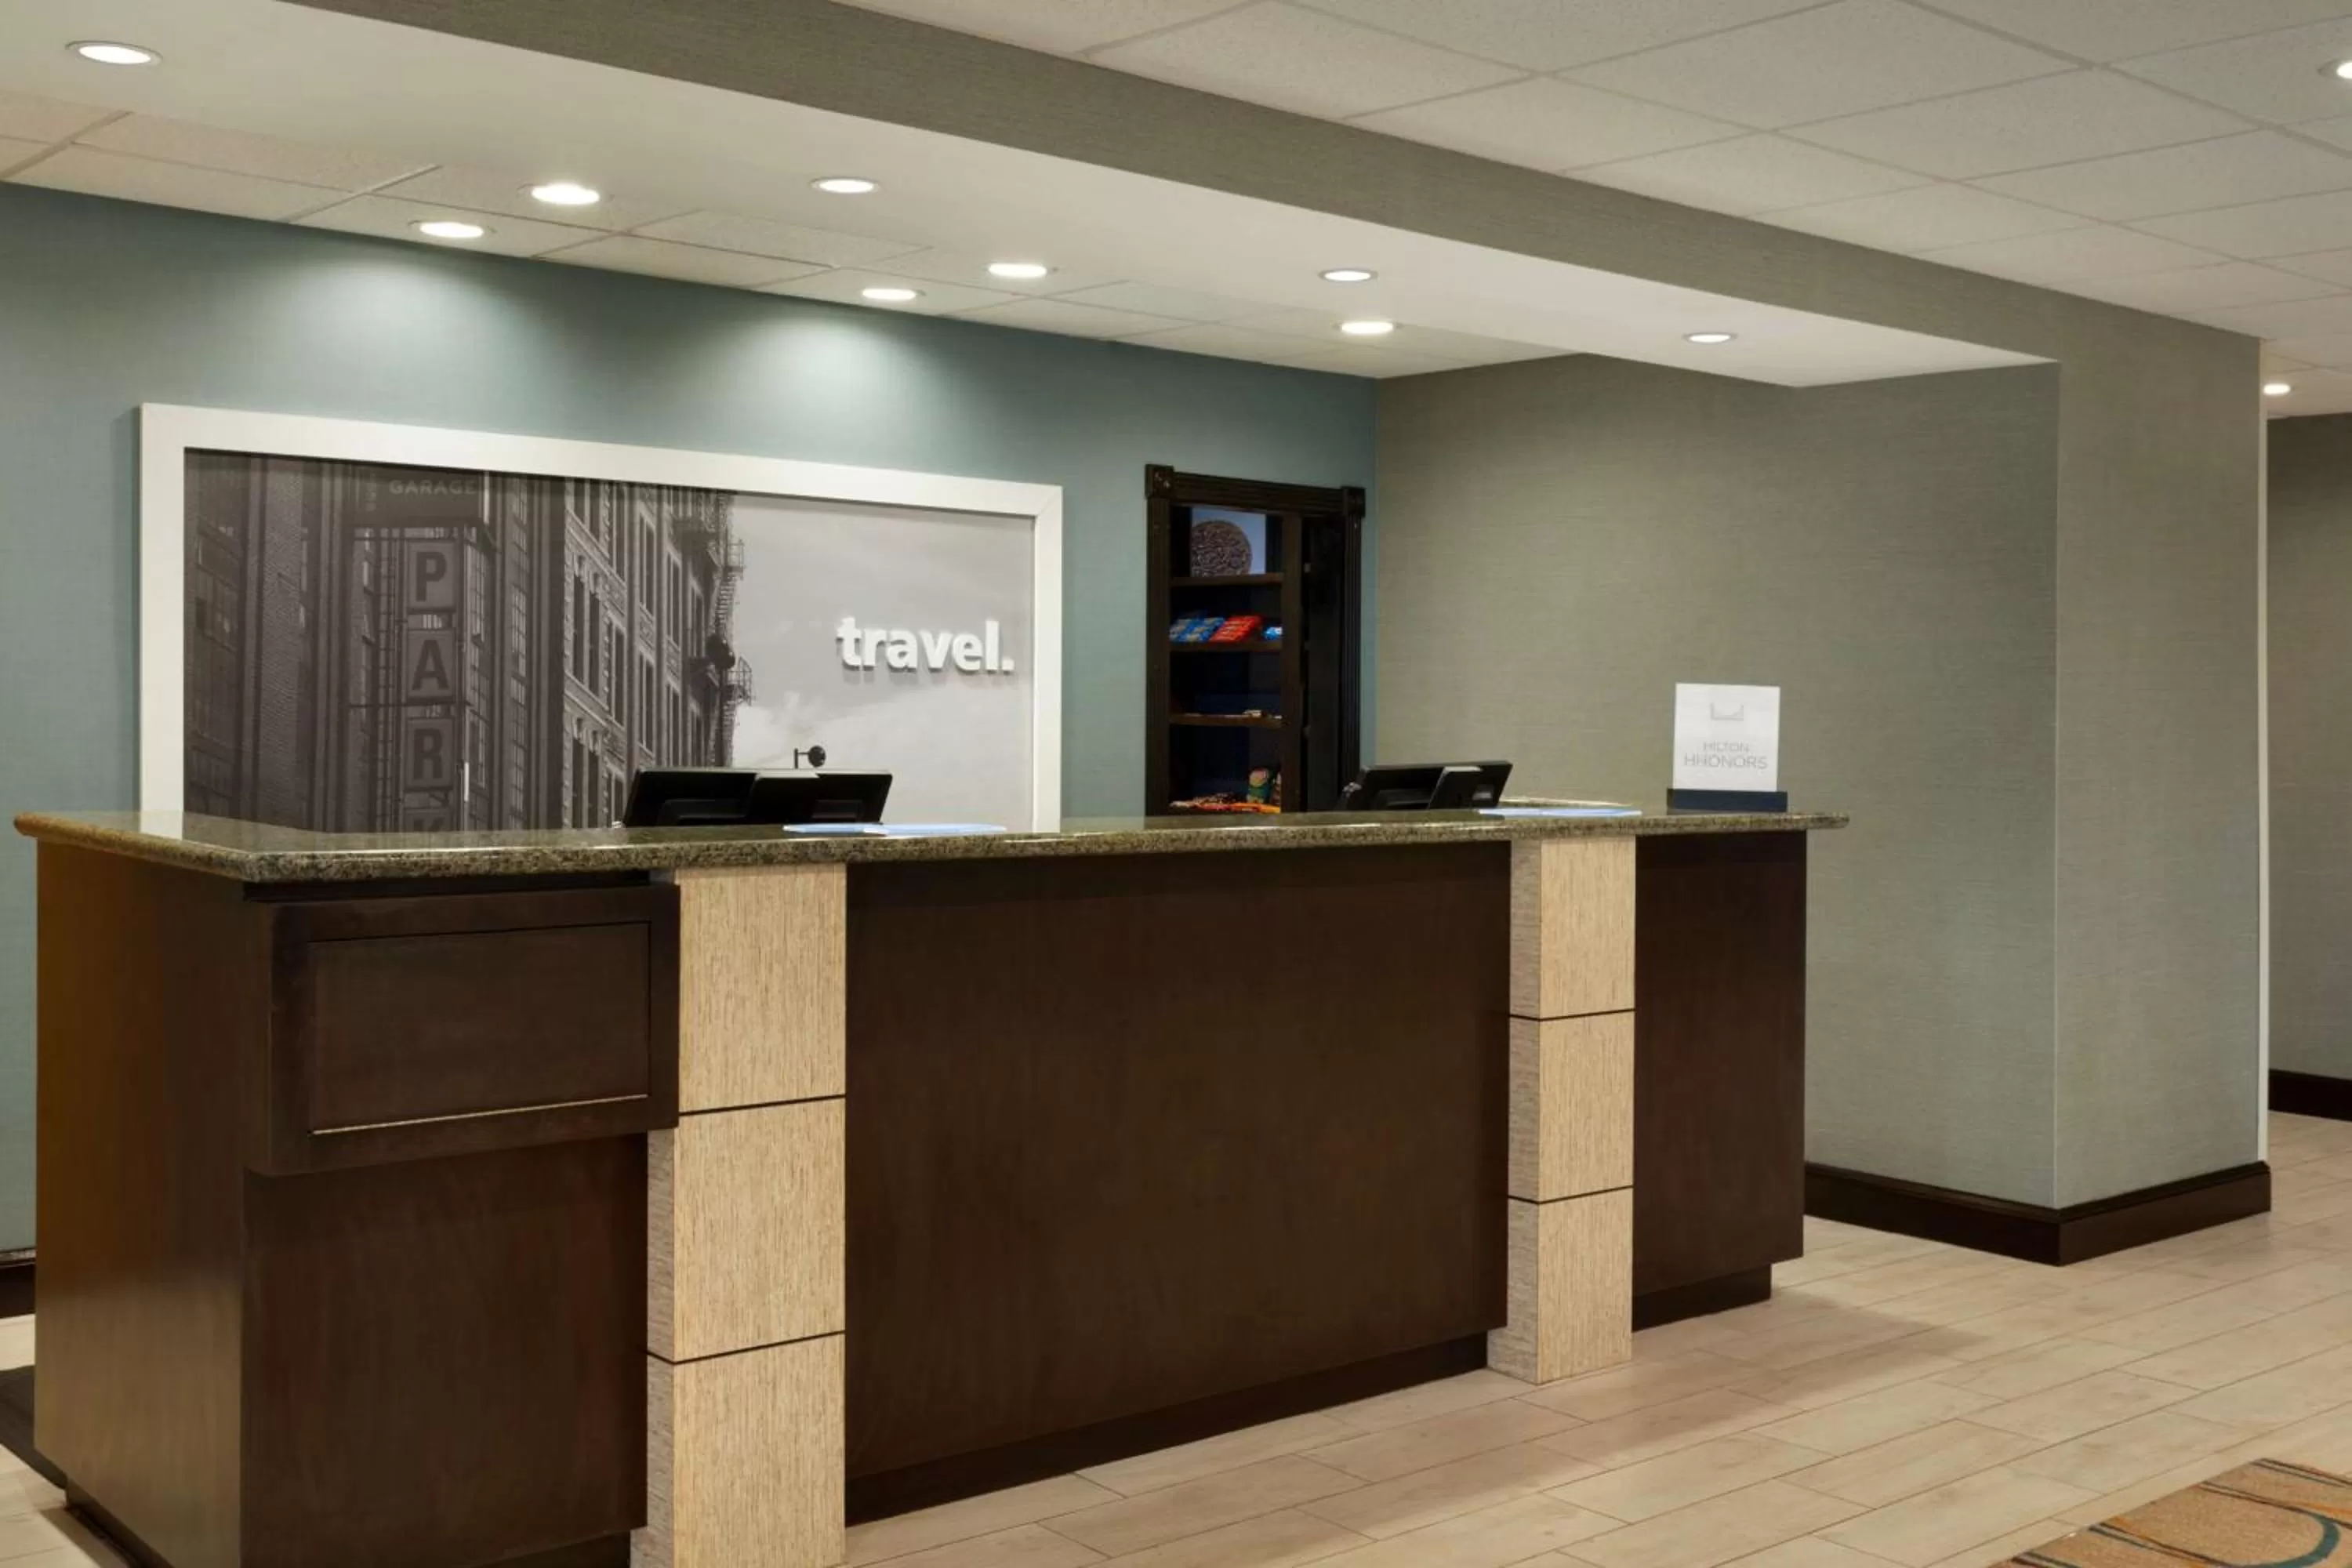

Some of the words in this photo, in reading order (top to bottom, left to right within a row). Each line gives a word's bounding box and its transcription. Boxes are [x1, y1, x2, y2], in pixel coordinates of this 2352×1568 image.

[389, 479, 477, 495] GARAGE
[836, 616, 1015, 672] travel.
[412, 551, 450, 832] PAR
[1702, 741, 1750, 753] HILTON
[1683, 753, 1769, 770] HHONORS
